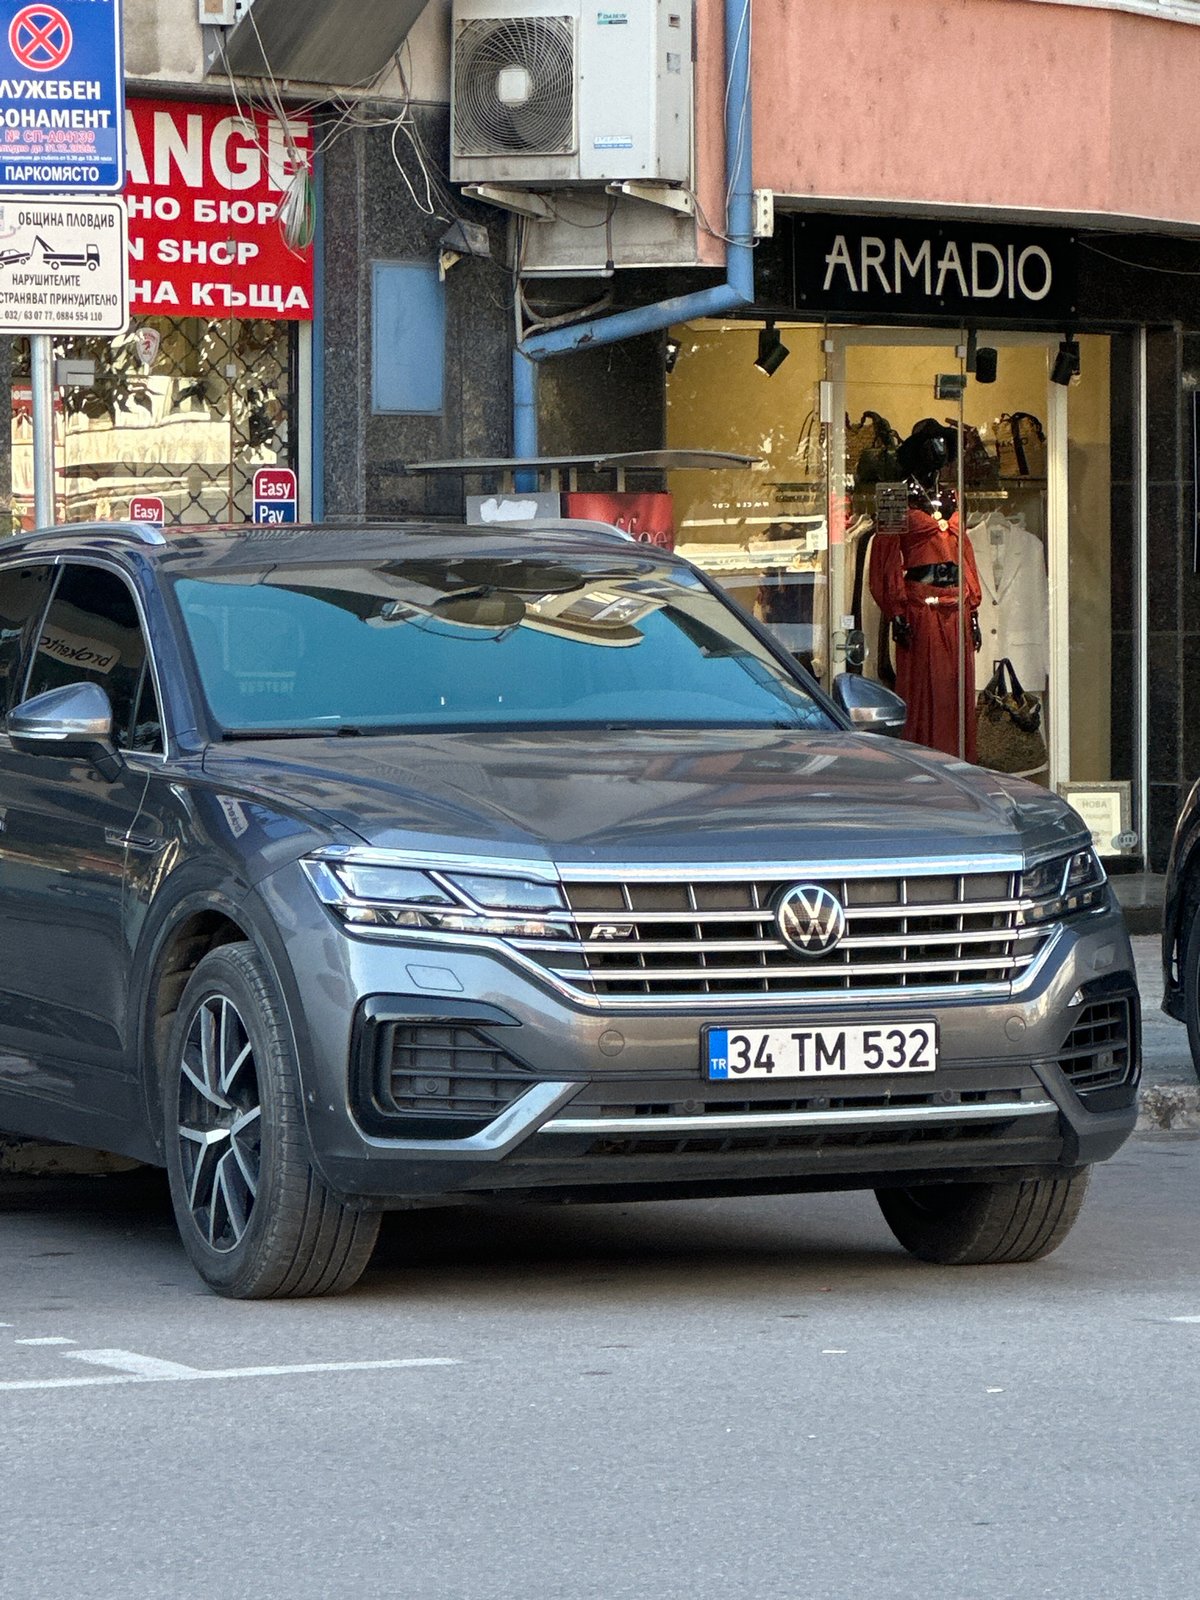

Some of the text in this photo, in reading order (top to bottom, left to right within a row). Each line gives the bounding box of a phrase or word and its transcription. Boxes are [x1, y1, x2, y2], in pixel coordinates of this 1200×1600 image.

[5, 166, 99, 182] ПАРКОМЯСТО
[116, 194, 181, 221] НО
[18, 212, 64, 228] ОБЩИНА
[66, 213, 115, 230] ПЛОВДИВ
[157, 238, 259, 265] SHOP
[823, 234, 1052, 301] ARMADIO
[12, 274, 81, 287] НАРУШИТЕЛИТЕ
[50, 293, 118, 307] ПРИНУДИТЕЛНО
[192, 282, 309, 312] КЪЩА
[34, 311, 42, 320] 07
[259, 478, 291, 499] Easy
[134, 504, 159, 521] Easy
[259, 506, 284, 523] Pay
[711, 1028, 929, 1074] TR 34 TM 532
